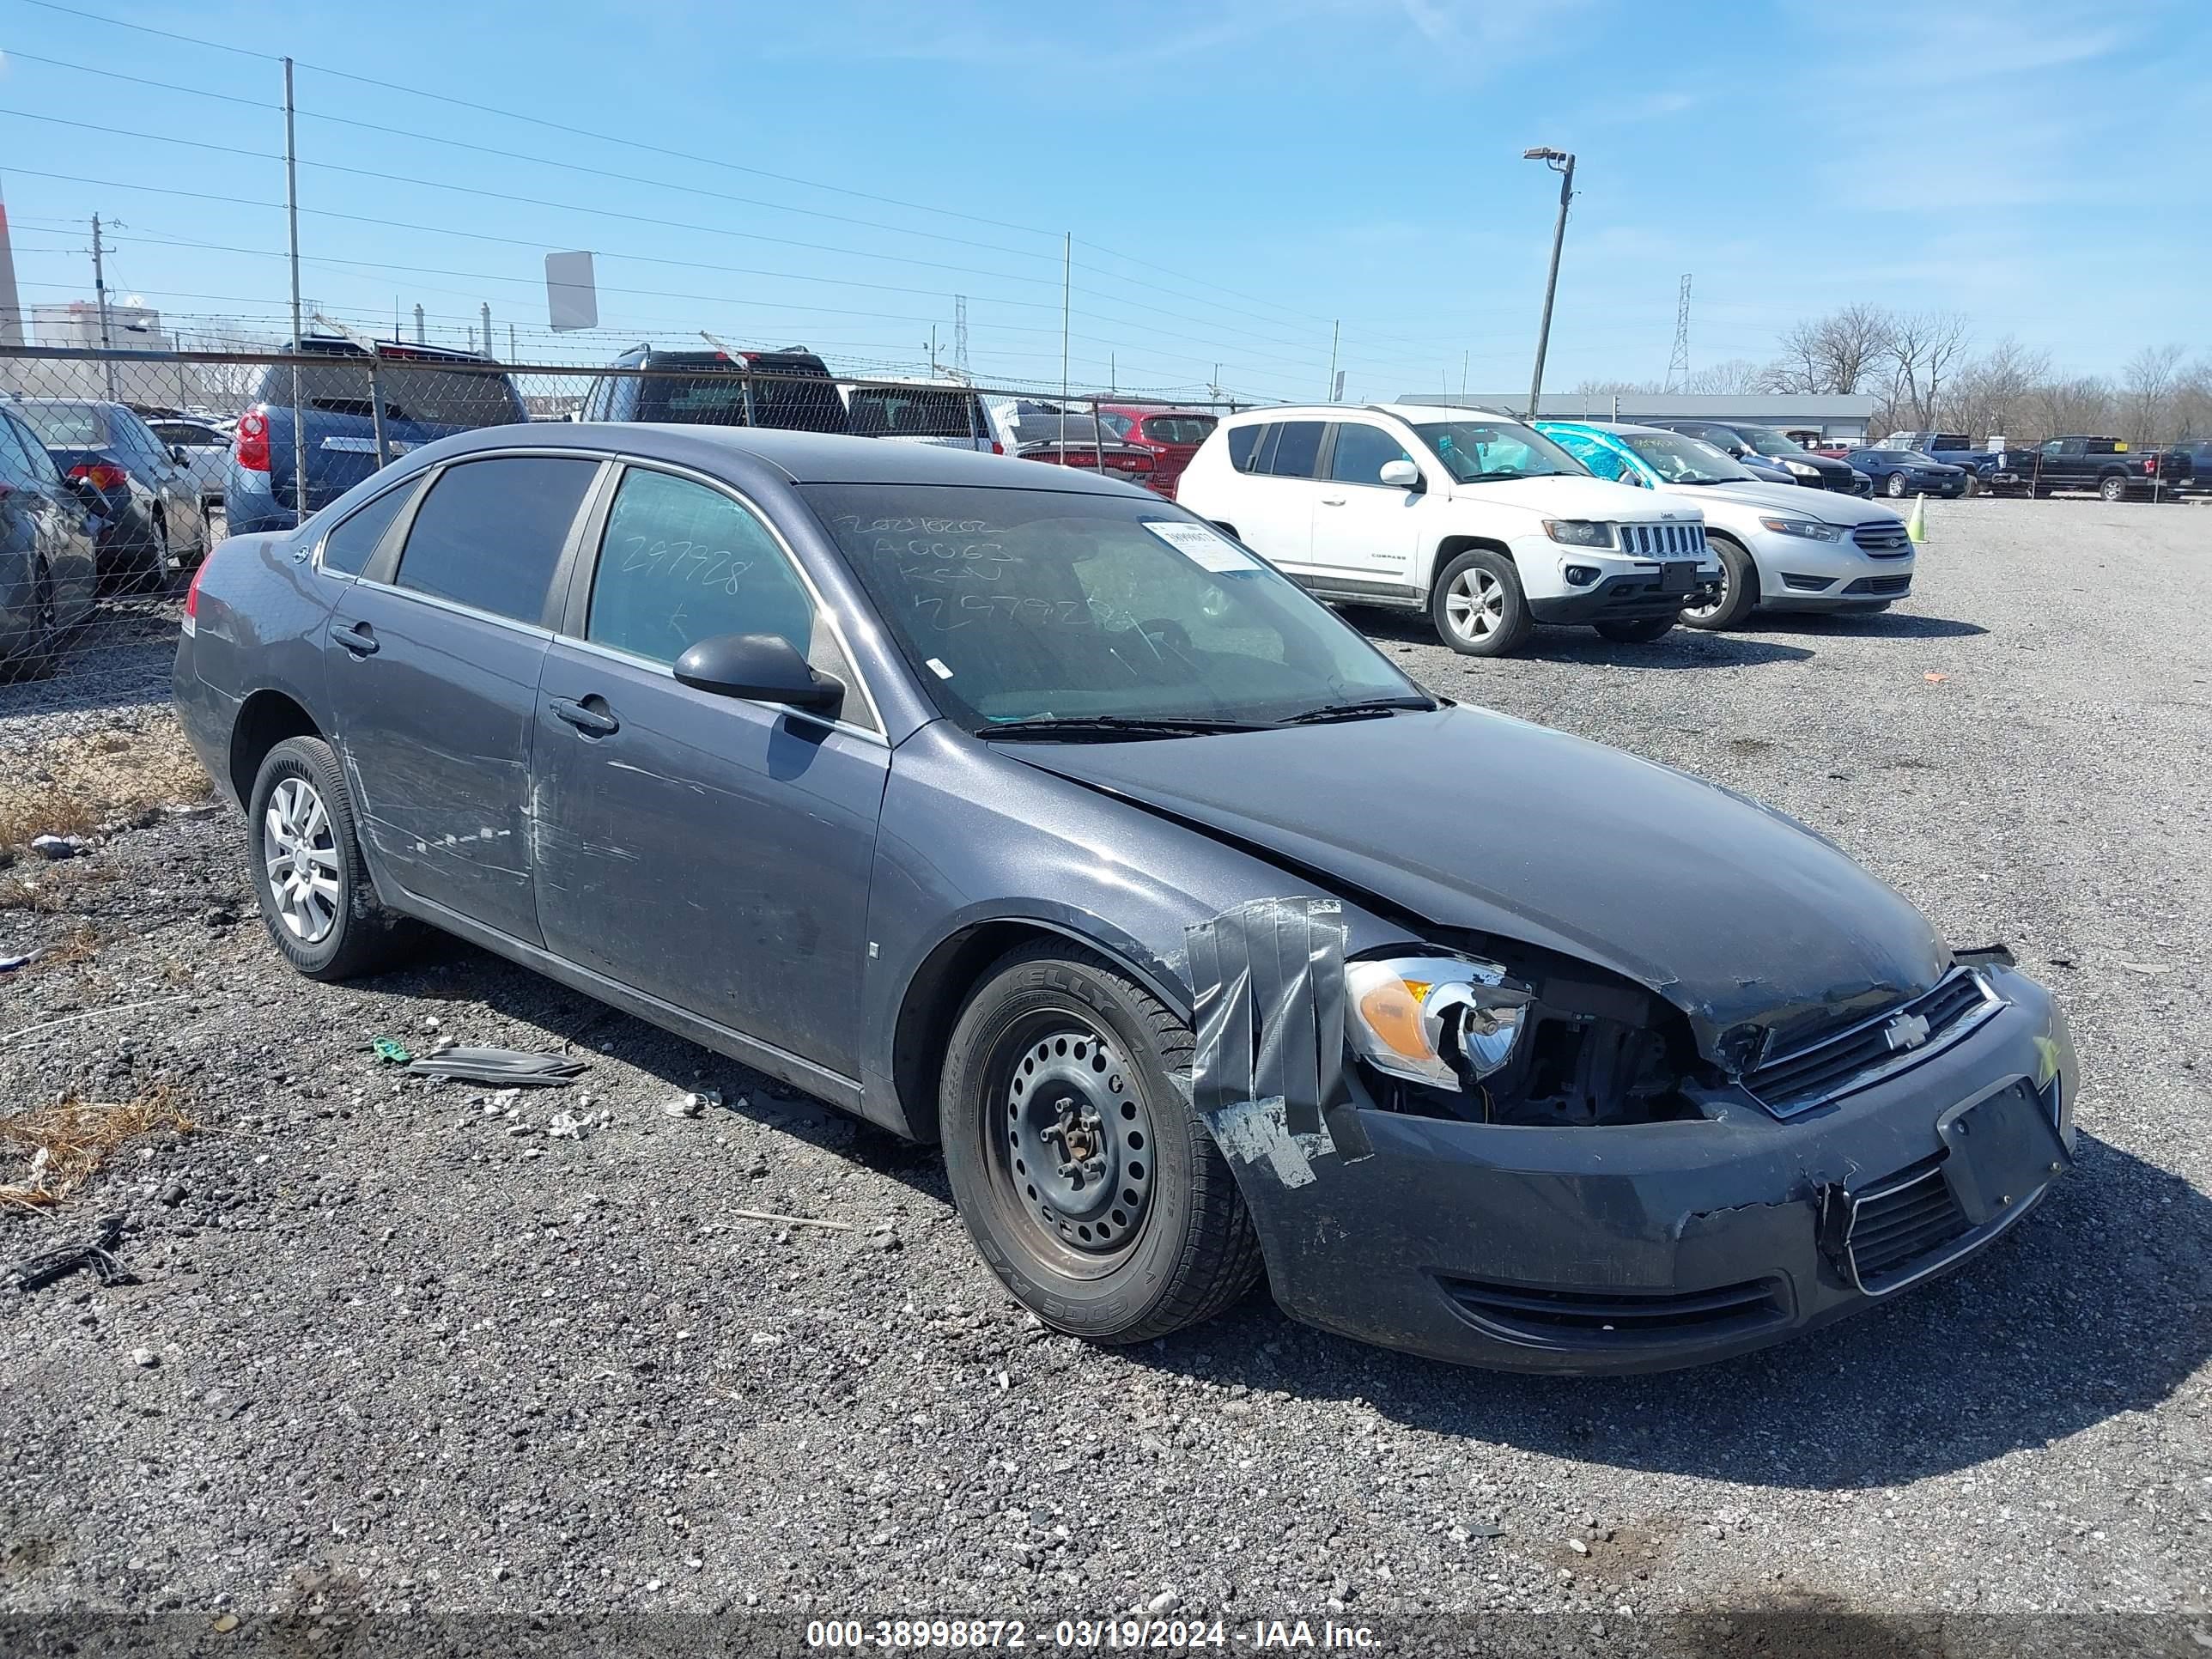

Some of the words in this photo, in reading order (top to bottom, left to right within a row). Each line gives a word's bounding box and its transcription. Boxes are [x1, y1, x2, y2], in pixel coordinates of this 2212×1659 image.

[623, 536, 754, 595] 297928
[1003, 968, 1117, 1012] KELLY
[1042, 1297, 1128, 1323] EDGE
